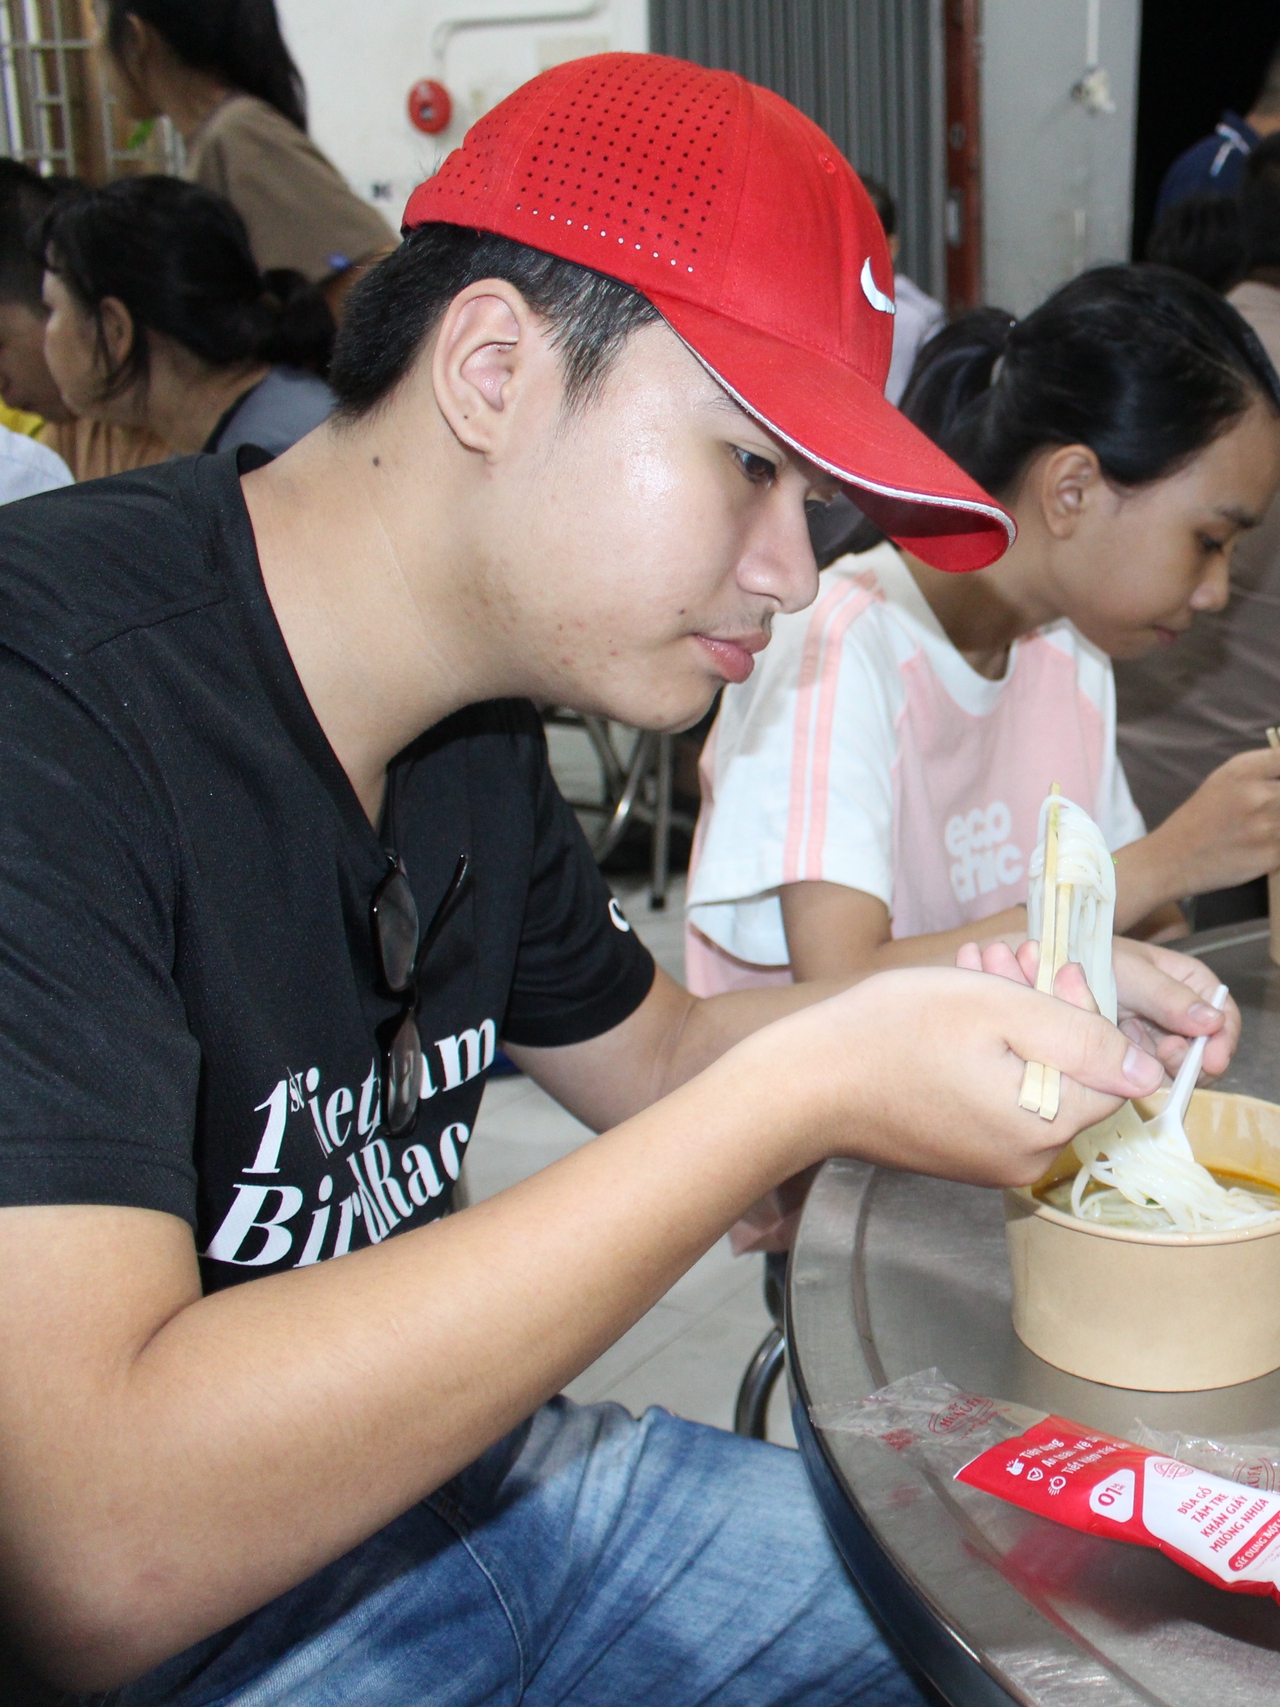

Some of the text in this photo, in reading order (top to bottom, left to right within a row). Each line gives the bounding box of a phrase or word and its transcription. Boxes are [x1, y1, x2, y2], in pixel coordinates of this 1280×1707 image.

[945, 800, 1013, 858] eco
[204, 1152, 390, 1267] Bird
[1097, 1486, 1123, 1507] 01
[1177, 1498, 1200, 1515] ĐŨA
[1208, 1493, 1229, 1507] TRE
[1209, 1522, 1246, 1553] MUỖNG
[1240, 1498, 1270, 1525] NHỰA
